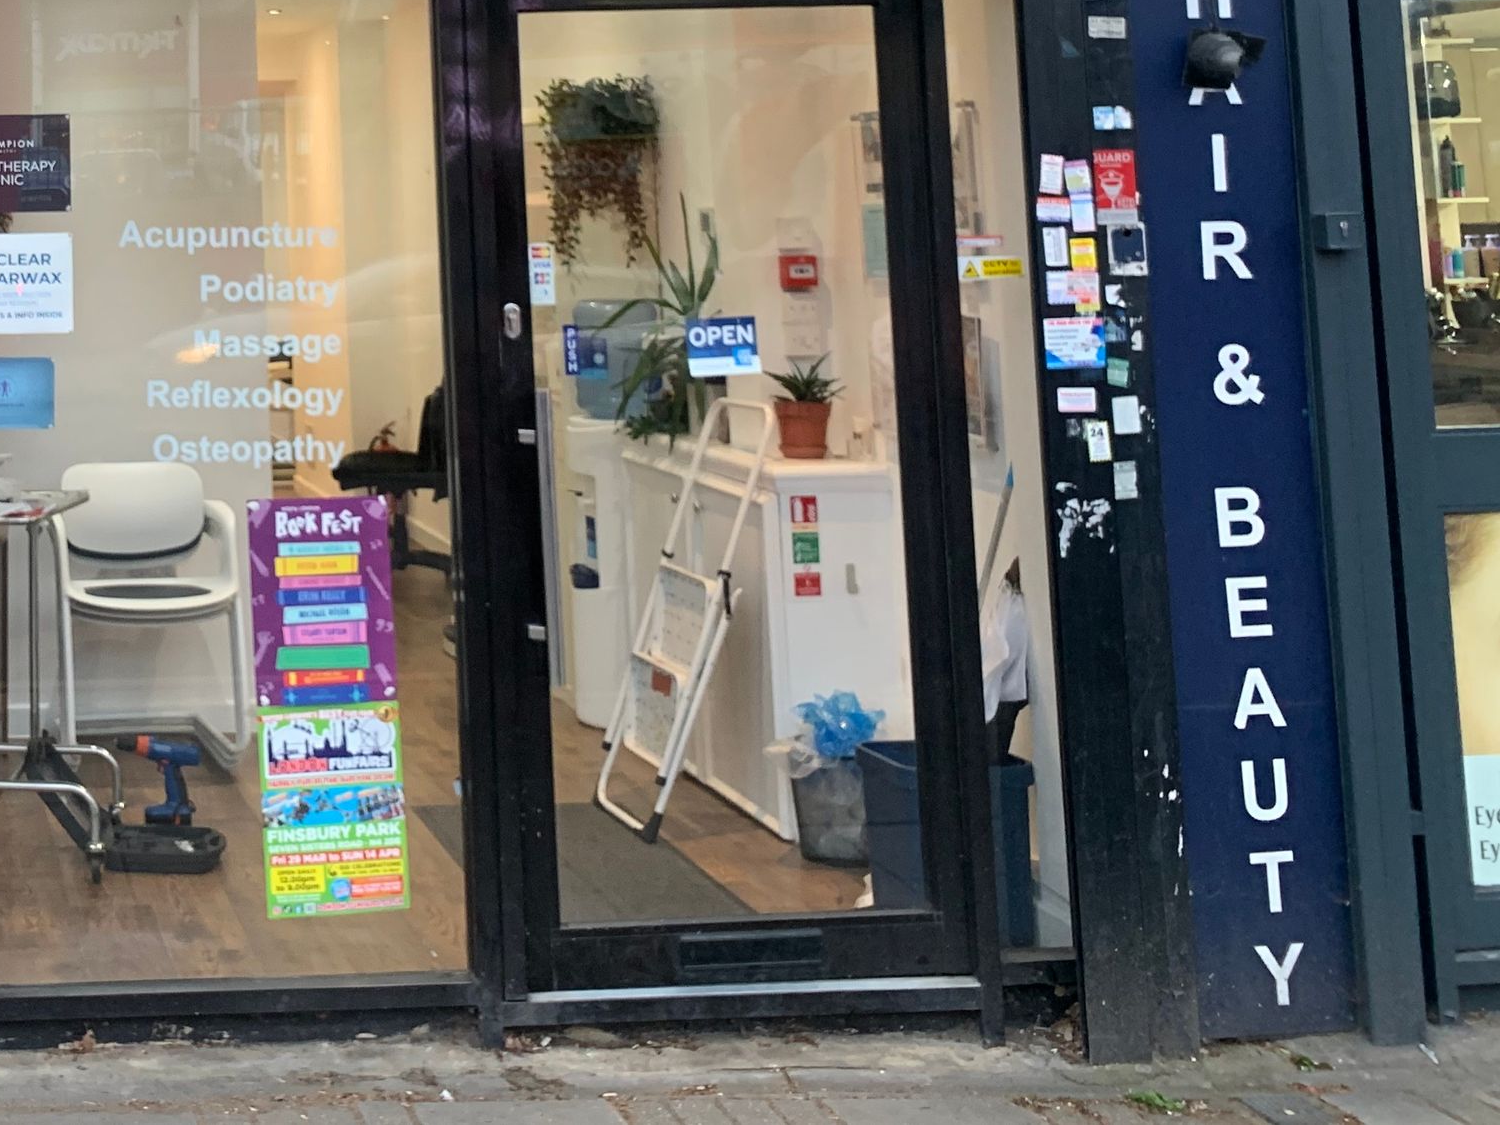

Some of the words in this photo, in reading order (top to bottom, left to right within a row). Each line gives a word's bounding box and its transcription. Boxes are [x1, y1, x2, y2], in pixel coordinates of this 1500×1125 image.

[118, 219, 338, 255] Acupuncture
[200, 273, 339, 308] Podiatry
[193, 328, 342, 364] Massage
[688, 323, 754, 348] OPEN
[146, 378, 344, 417] Reflexology
[152, 433, 346, 471] Osteopathy
[1213, 485, 1305, 1006] BEAUTY
[267, 825, 351, 844] FINSBURY
[354, 821, 401, 838] PARK
[379, 848, 401, 858] APR
